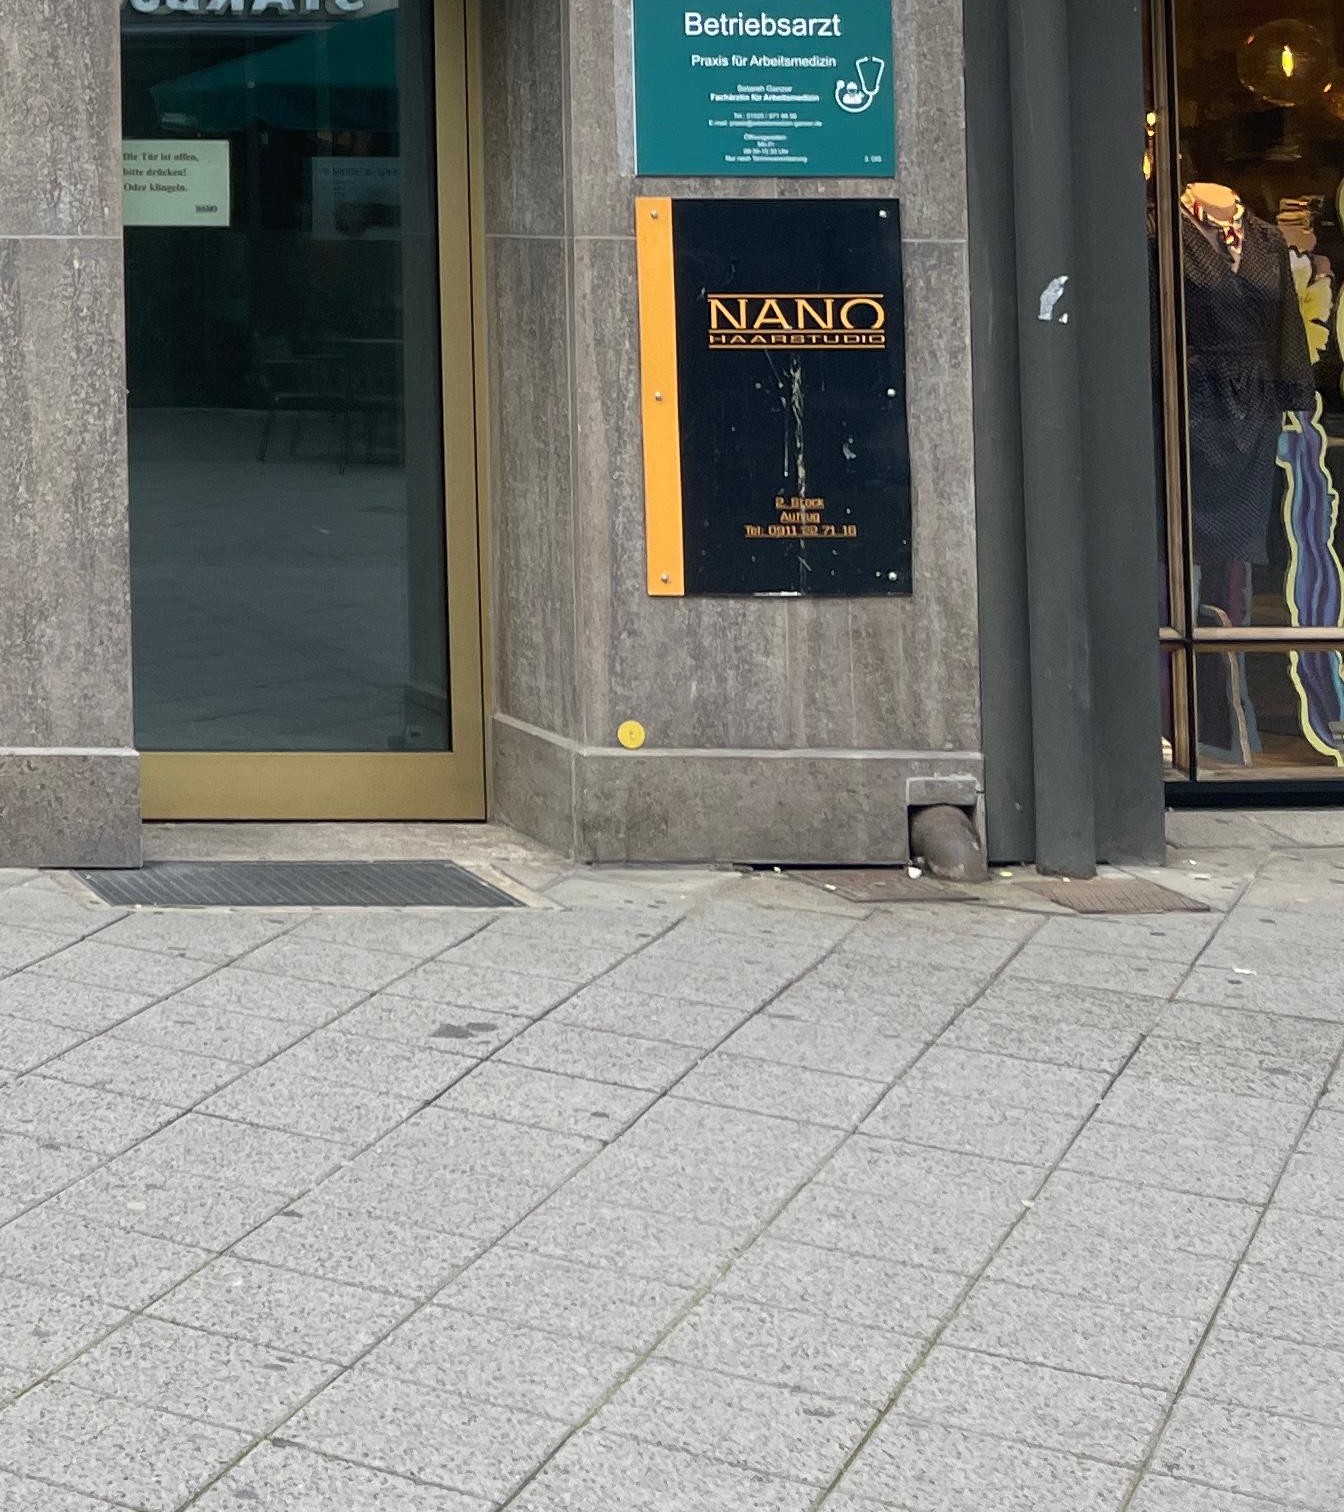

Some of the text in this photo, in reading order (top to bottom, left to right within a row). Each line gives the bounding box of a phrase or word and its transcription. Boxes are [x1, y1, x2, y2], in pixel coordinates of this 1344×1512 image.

[683, 11, 842, 37] Betriebsarzt
[691, 54, 837, 68] Praxis für Arbeitsmedizin
[142, 152, 159, 161] Tür
[161, 152, 172, 161] ist
[123, 183, 147, 192] Oder
[707, 299, 885, 330] NANO
[709, 334, 886, 344] HAARSTUDIO
